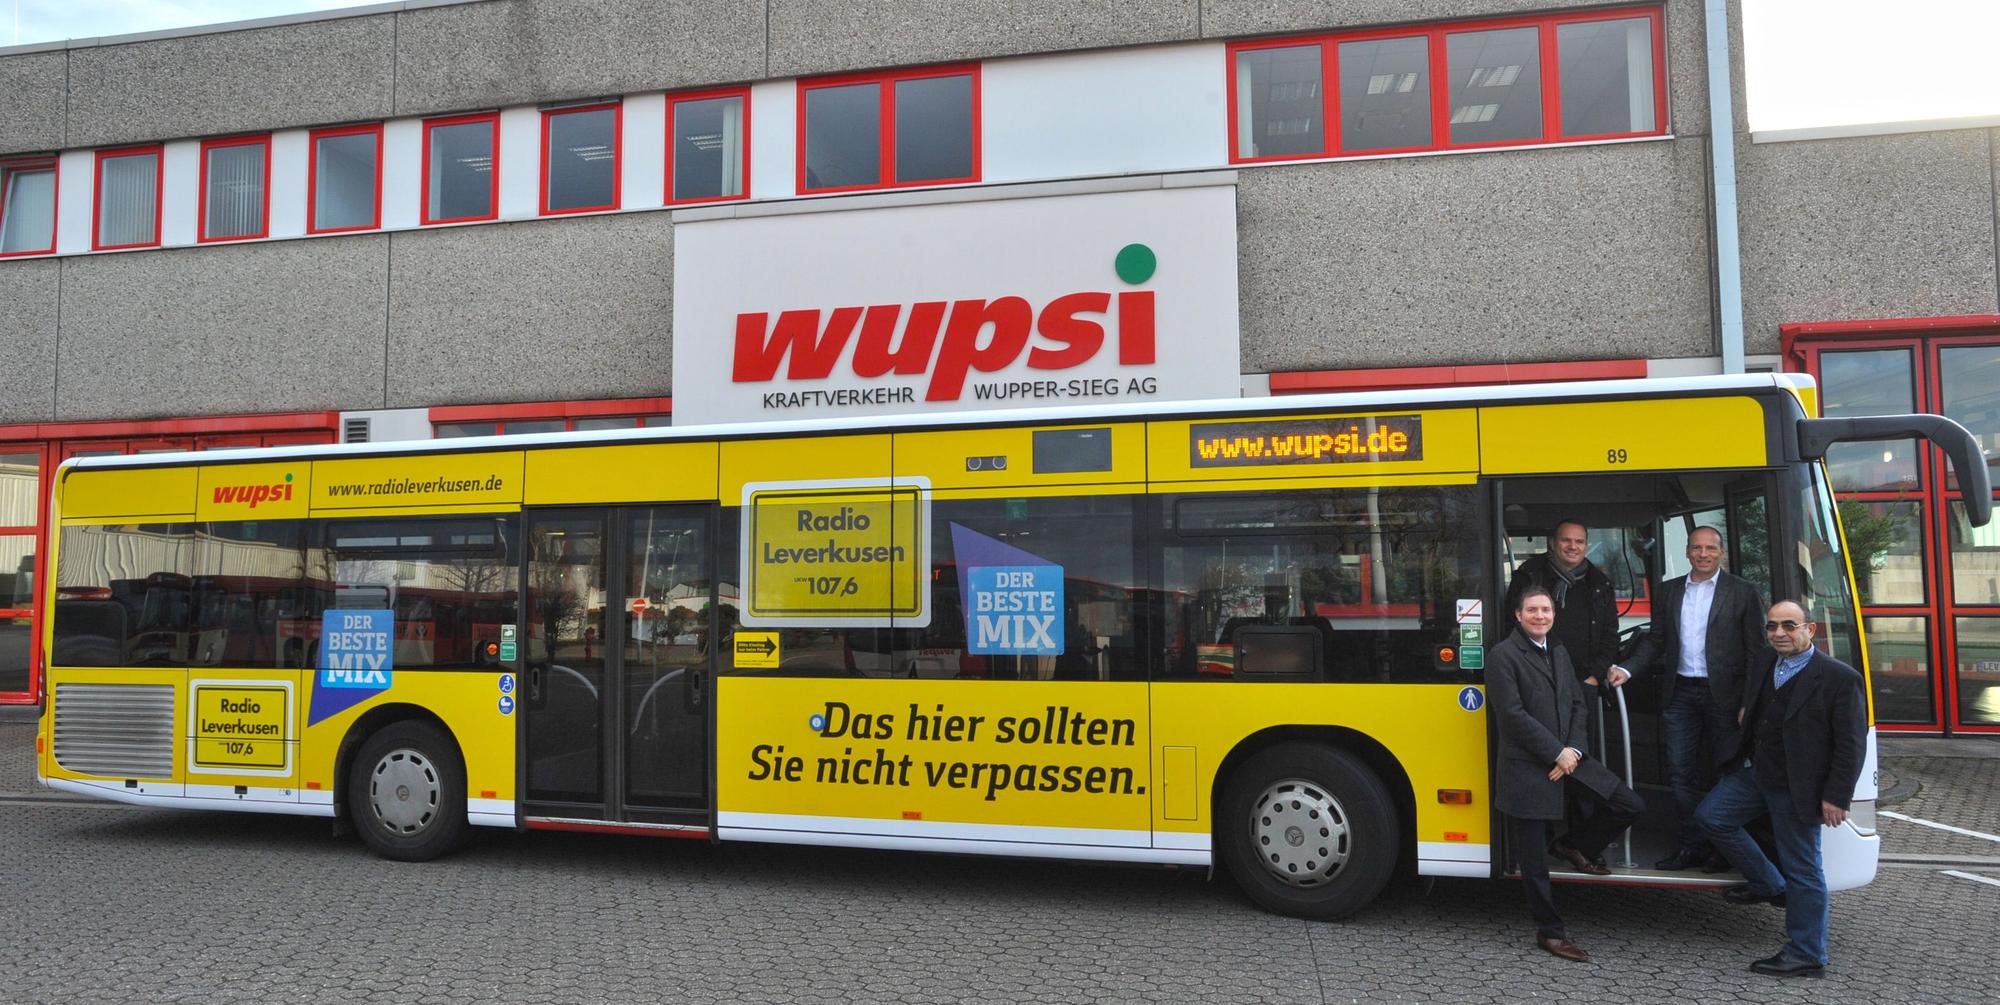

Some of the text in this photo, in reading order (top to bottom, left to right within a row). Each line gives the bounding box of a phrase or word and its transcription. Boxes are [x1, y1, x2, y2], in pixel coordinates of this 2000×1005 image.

[732, 243, 1156, 401] wupsi
[763, 377, 1157, 408] KRAFTVERKEHR WUPPER-SIEG AG
[1198, 425, 1407, 458] www.wupsi.de
[1607, 449, 1628, 463] 89
[213, 473, 292, 508] wupsi
[328, 475, 503, 496] www.radioleverkusen.de
[797, 508, 871, 532] Radio
[763, 540, 905, 565] Leverkusen
[808, 576, 858, 597] 107,6
[996, 571, 1034, 588] DER
[976, 590, 1055, 612] BESTE
[343, 615, 372, 629] DER
[976, 614, 1056, 648] MIX
[328, 632, 387, 651] BESTE
[327, 653, 387, 683] MIX
[221, 698, 261, 713] Radio
[202, 719, 279, 735] Leverkusen
[820, 702, 1136, 747] Das hier sollten
[226, 743, 254, 756] 107,6
[748, 744, 1146, 801] Sie nicht verpassen.
